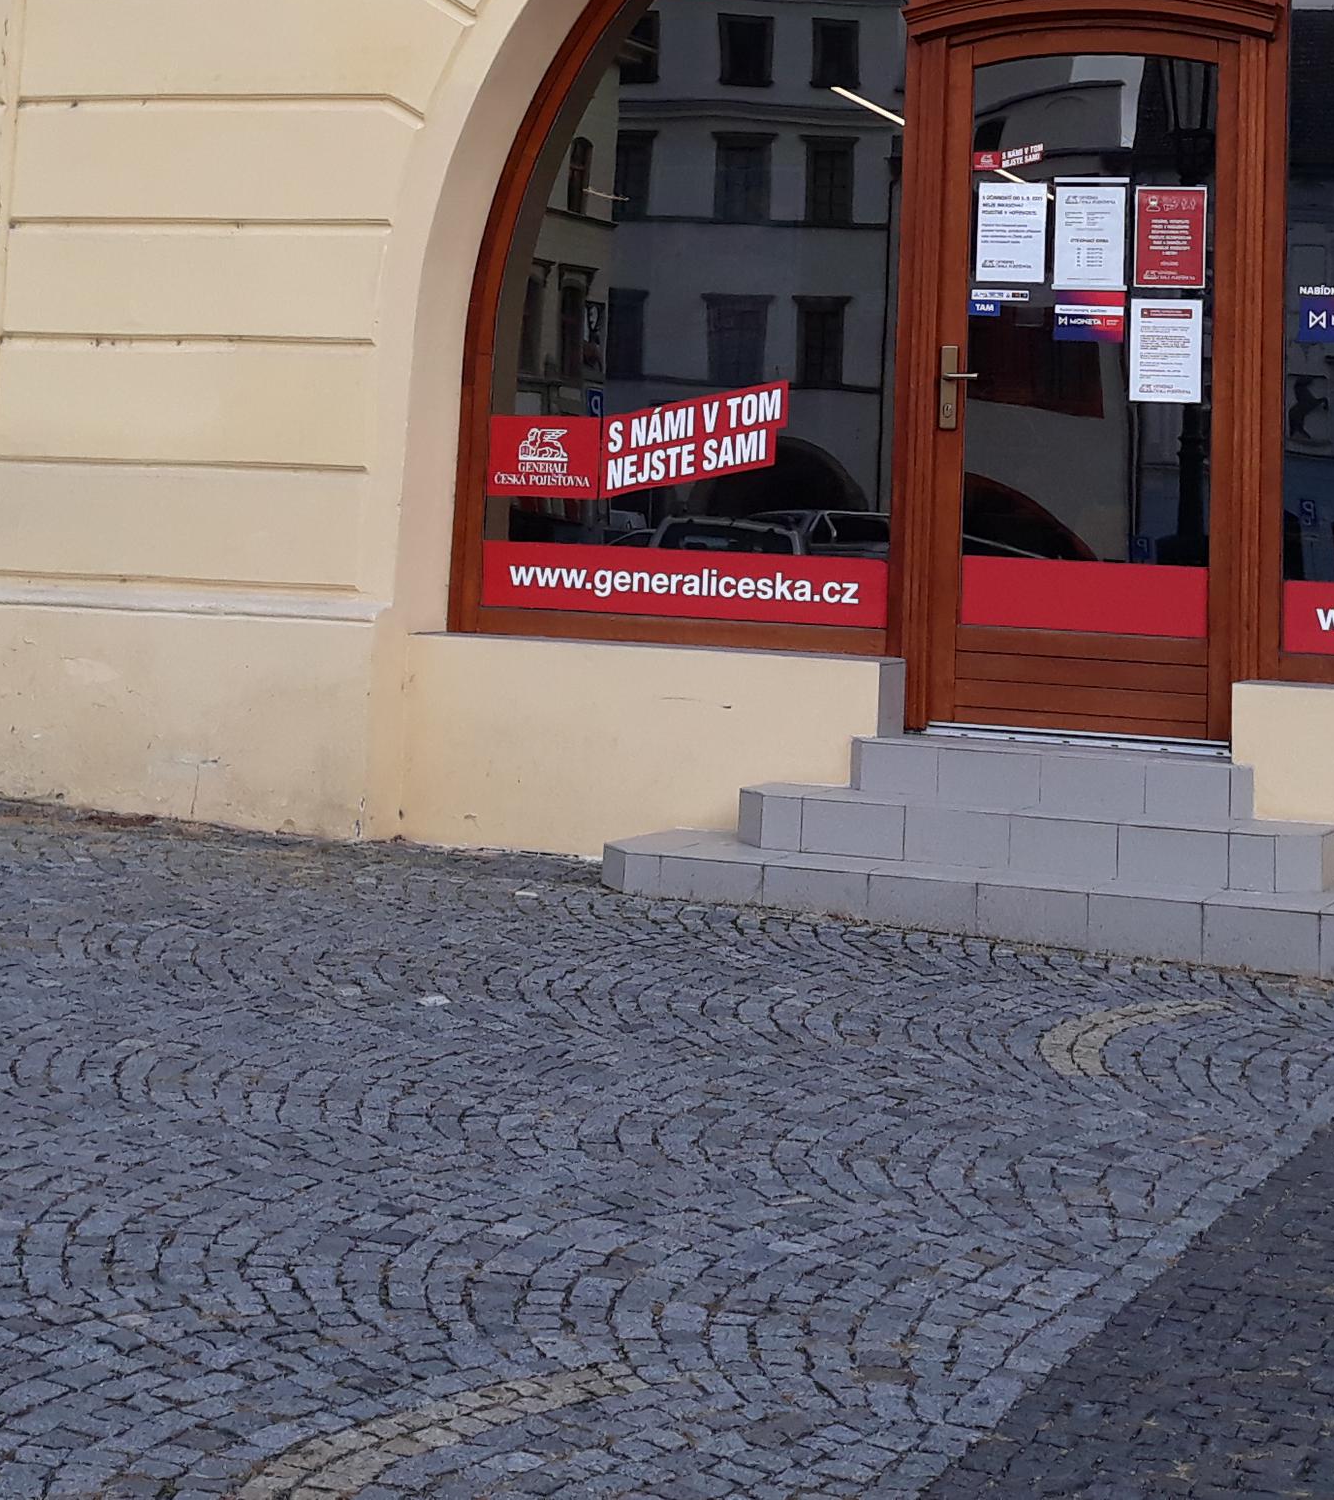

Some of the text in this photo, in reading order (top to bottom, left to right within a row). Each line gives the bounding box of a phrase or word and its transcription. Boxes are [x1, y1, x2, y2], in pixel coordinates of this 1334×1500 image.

[975, 303, 995, 312] TAM
[608, 388, 782, 454] S NÁMI V TOM
[518, 461, 567, 474] GENERALI
[606, 428, 767, 492] NEJSTE SAMI
[494, 472, 590, 488] ČESKÁ POJIŠŤOVNA
[509, 564, 860, 605] www.generaliceska.cz
